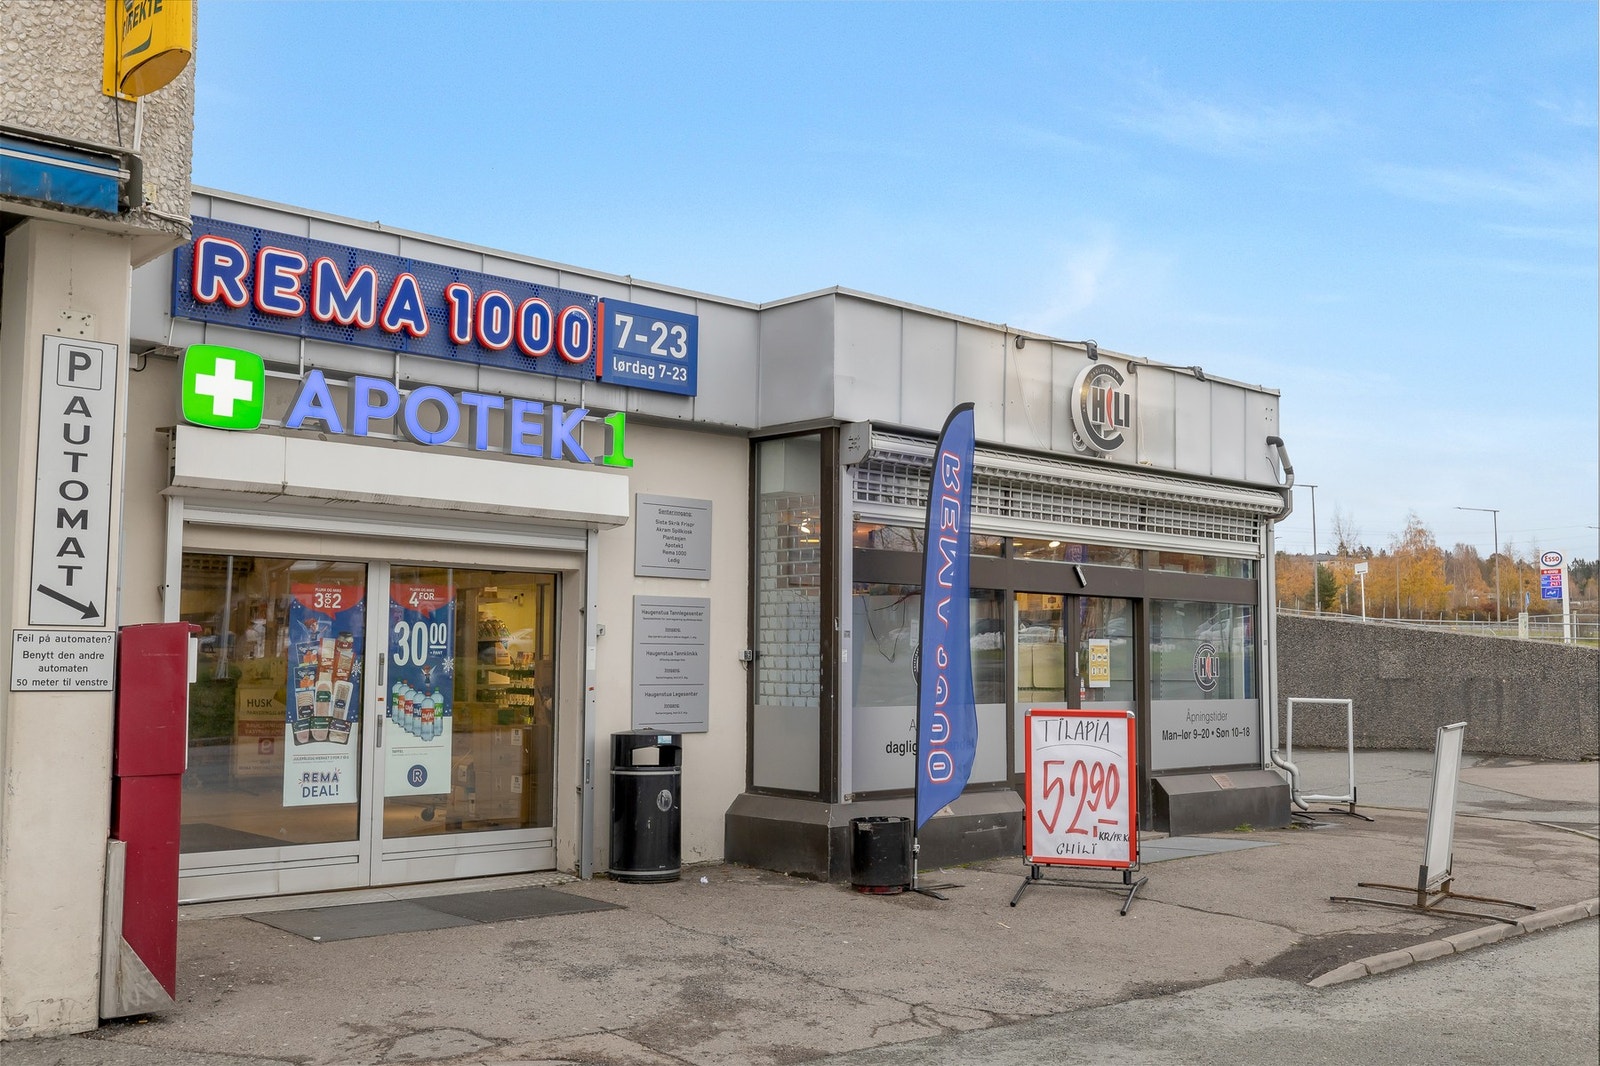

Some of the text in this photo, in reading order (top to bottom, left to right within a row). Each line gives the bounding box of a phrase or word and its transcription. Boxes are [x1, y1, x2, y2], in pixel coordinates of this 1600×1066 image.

[192, 234, 595, 364] REMA 1000
[615, 313, 687, 359] 7-23
[67, 350, 92, 382] P
[613, 356, 687, 382] lørdag 7-23
[284, 369, 634, 468] APOTEK 1
[55, 395, 93, 587] AUTOMAT
[314, 592, 342, 609] 3 FOR 2
[409, 591, 435, 608] 4 FOR
[16, 633, 112, 645] Feil på automaten?
[393, 620, 429, 666] 30
[22, 650, 105, 661] Benytt den andre
[38, 664, 89, 673] automaten
[16, 678, 28, 687] 50
[32, 678, 59, 686] meter
[63, 677, 71, 686] til
[246, 699, 273, 708] HUSK
[1186, 707, 1228, 725] Åpningstider
[1037, 717, 1111, 743] TILAPIA
[1215, 727, 1230, 738] Søn
[302, 771, 340, 783] REMA
[412, 768, 423, 783] R
[302, 784, 339, 798] DEAL!
